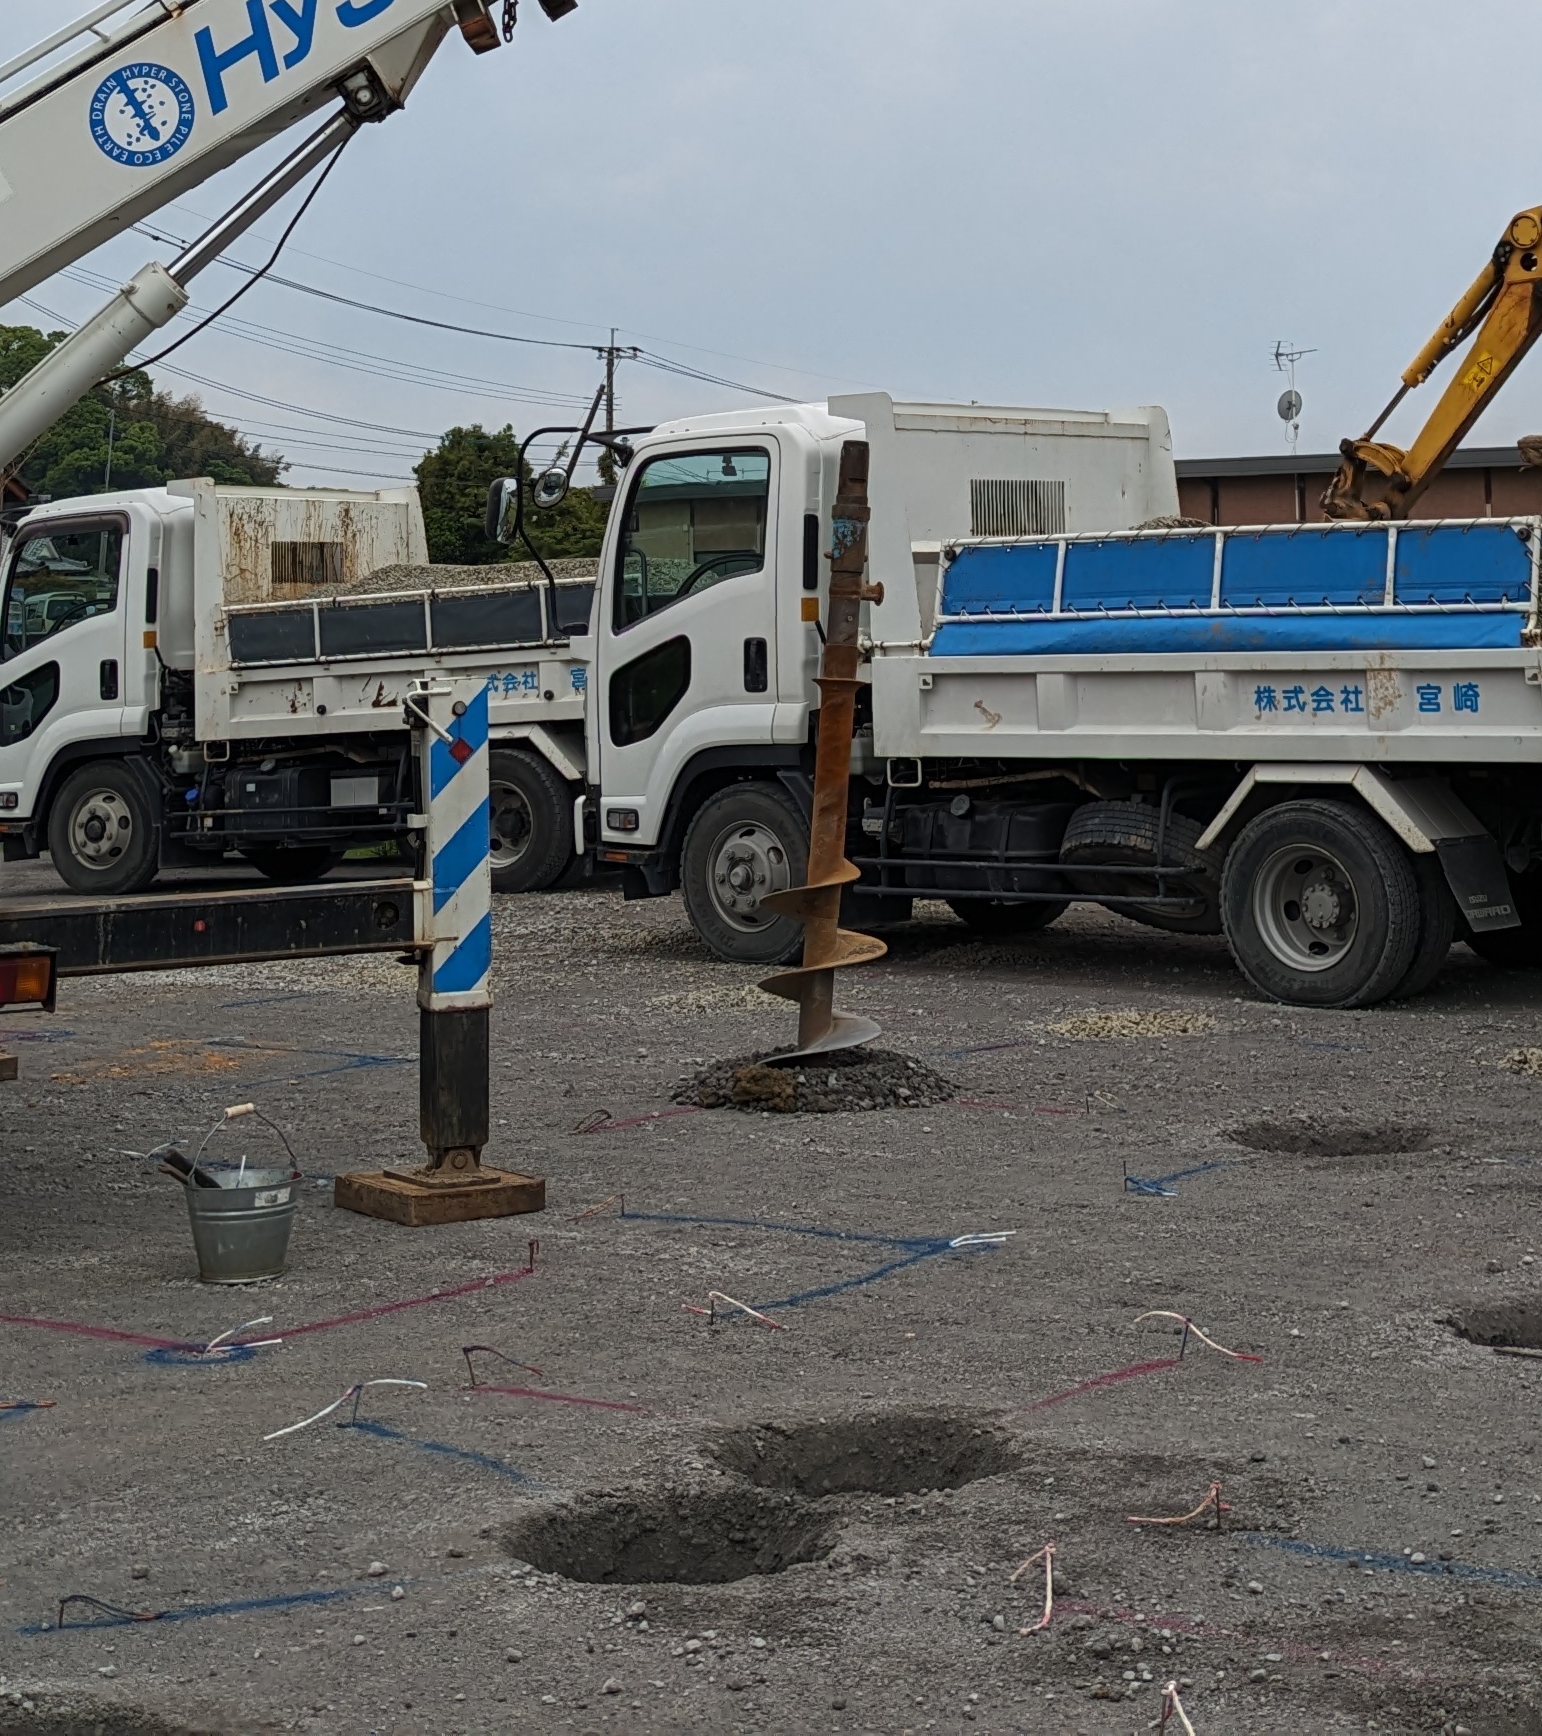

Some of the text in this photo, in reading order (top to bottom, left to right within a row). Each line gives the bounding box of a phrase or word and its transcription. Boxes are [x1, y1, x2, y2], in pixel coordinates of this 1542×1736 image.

[91, 65, 192, 164] HYPER STONE PILE ECO EARTH DRAIN
[487, 667, 587, 693] 式会社 宮
[1254, 684, 1365, 713] 株式会社
